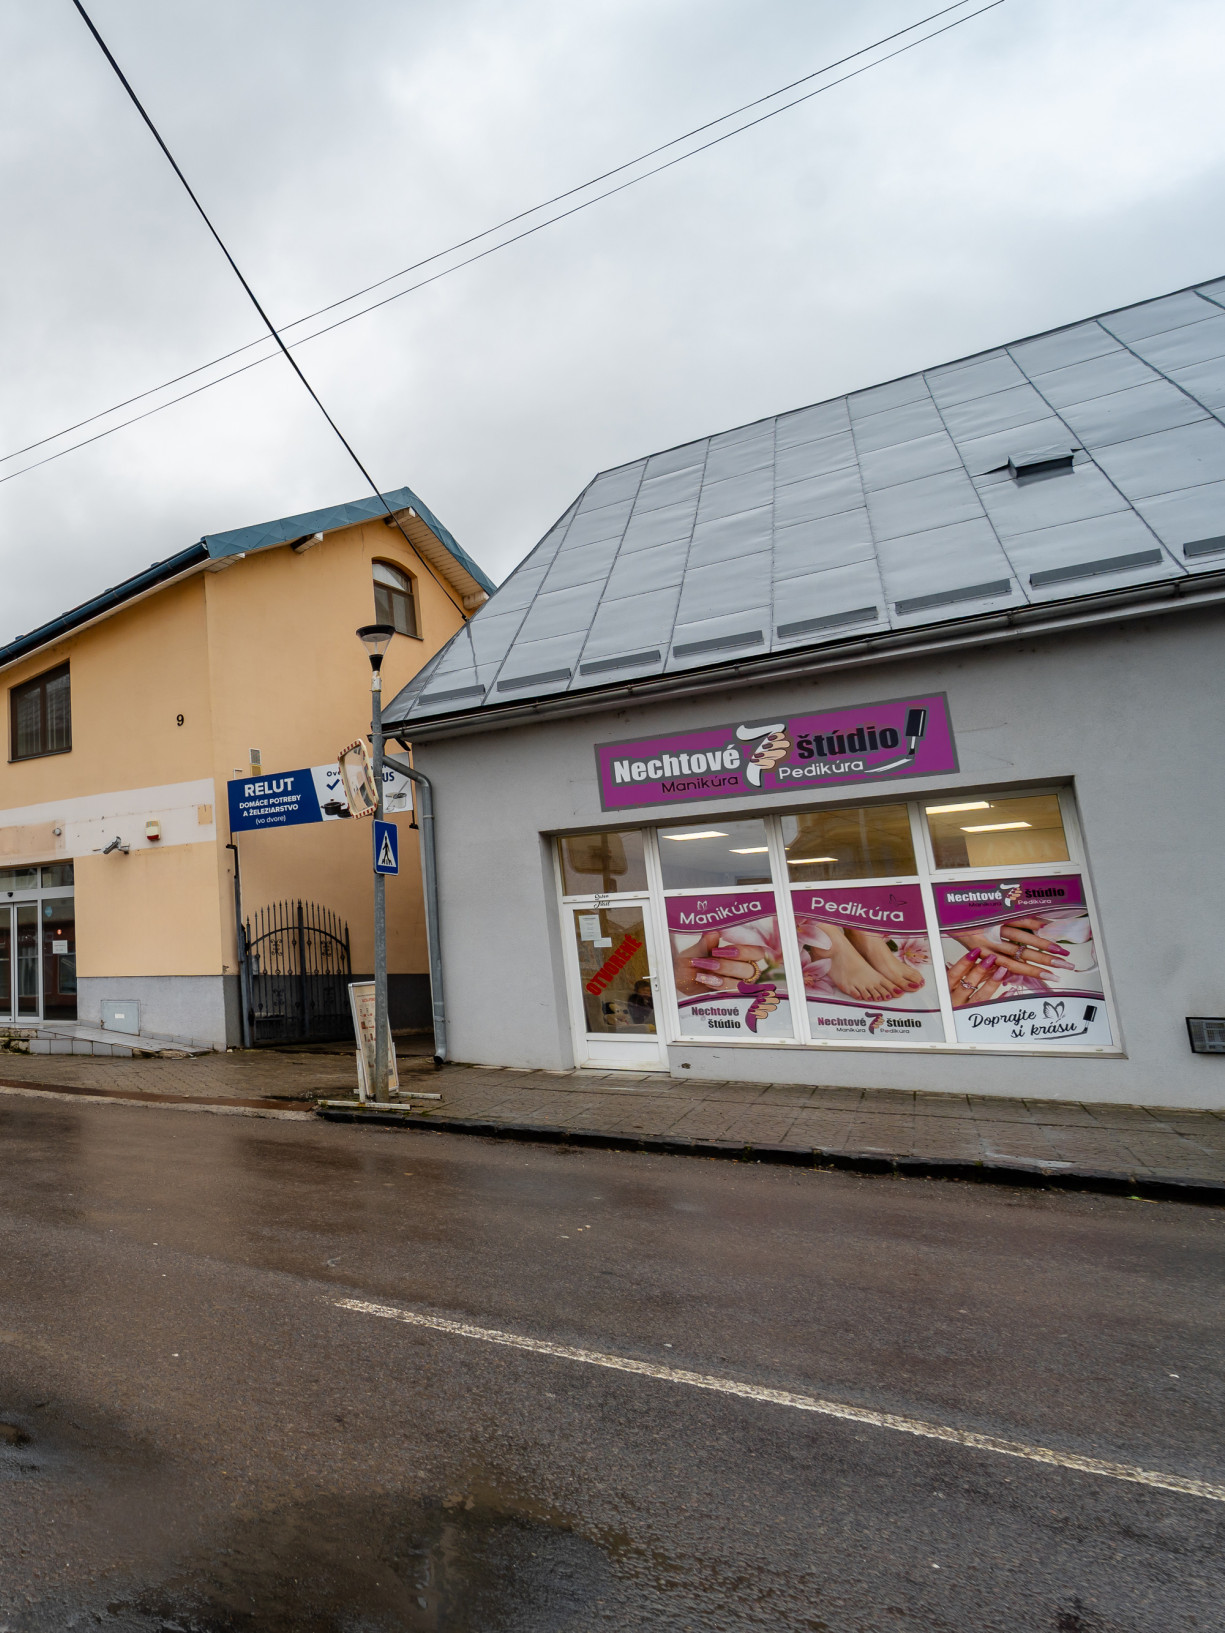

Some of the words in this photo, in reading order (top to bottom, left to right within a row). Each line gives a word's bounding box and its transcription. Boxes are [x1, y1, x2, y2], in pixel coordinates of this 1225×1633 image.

[176, 713, 184, 727] 9
[613, 744, 741, 783] Nechtové
[796, 726, 900, 759] štúdio
[661, 775, 739, 793] Manikúra
[778, 760, 864, 780] Pedikúra
[244, 777, 294, 797] RELUT
[239, 798, 268, 809] DOMÁCE
[269, 795, 301, 805] POTREBY
[249, 804, 299, 816] ŽELEZIARSTVO
[266, 815, 286, 823] dvore)
[946, 890, 1003, 902] Nechtové
[1025, 888, 1065, 899] štúdio
[679, 901, 762, 925] Manikúra
[811, 897, 905, 921] Pedikúra
[691, 1006, 739, 1016] Nechtové
[708, 1018, 741, 1029] štúdio
[817, 1017, 867, 1027] Nechtové
[886, 1017, 922, 1028] štúdio
[967, 1009, 1037, 1028] Doprajte
[1011, 1024, 1026, 1038] si
[1030, 1021, 1077, 1036] krásu
